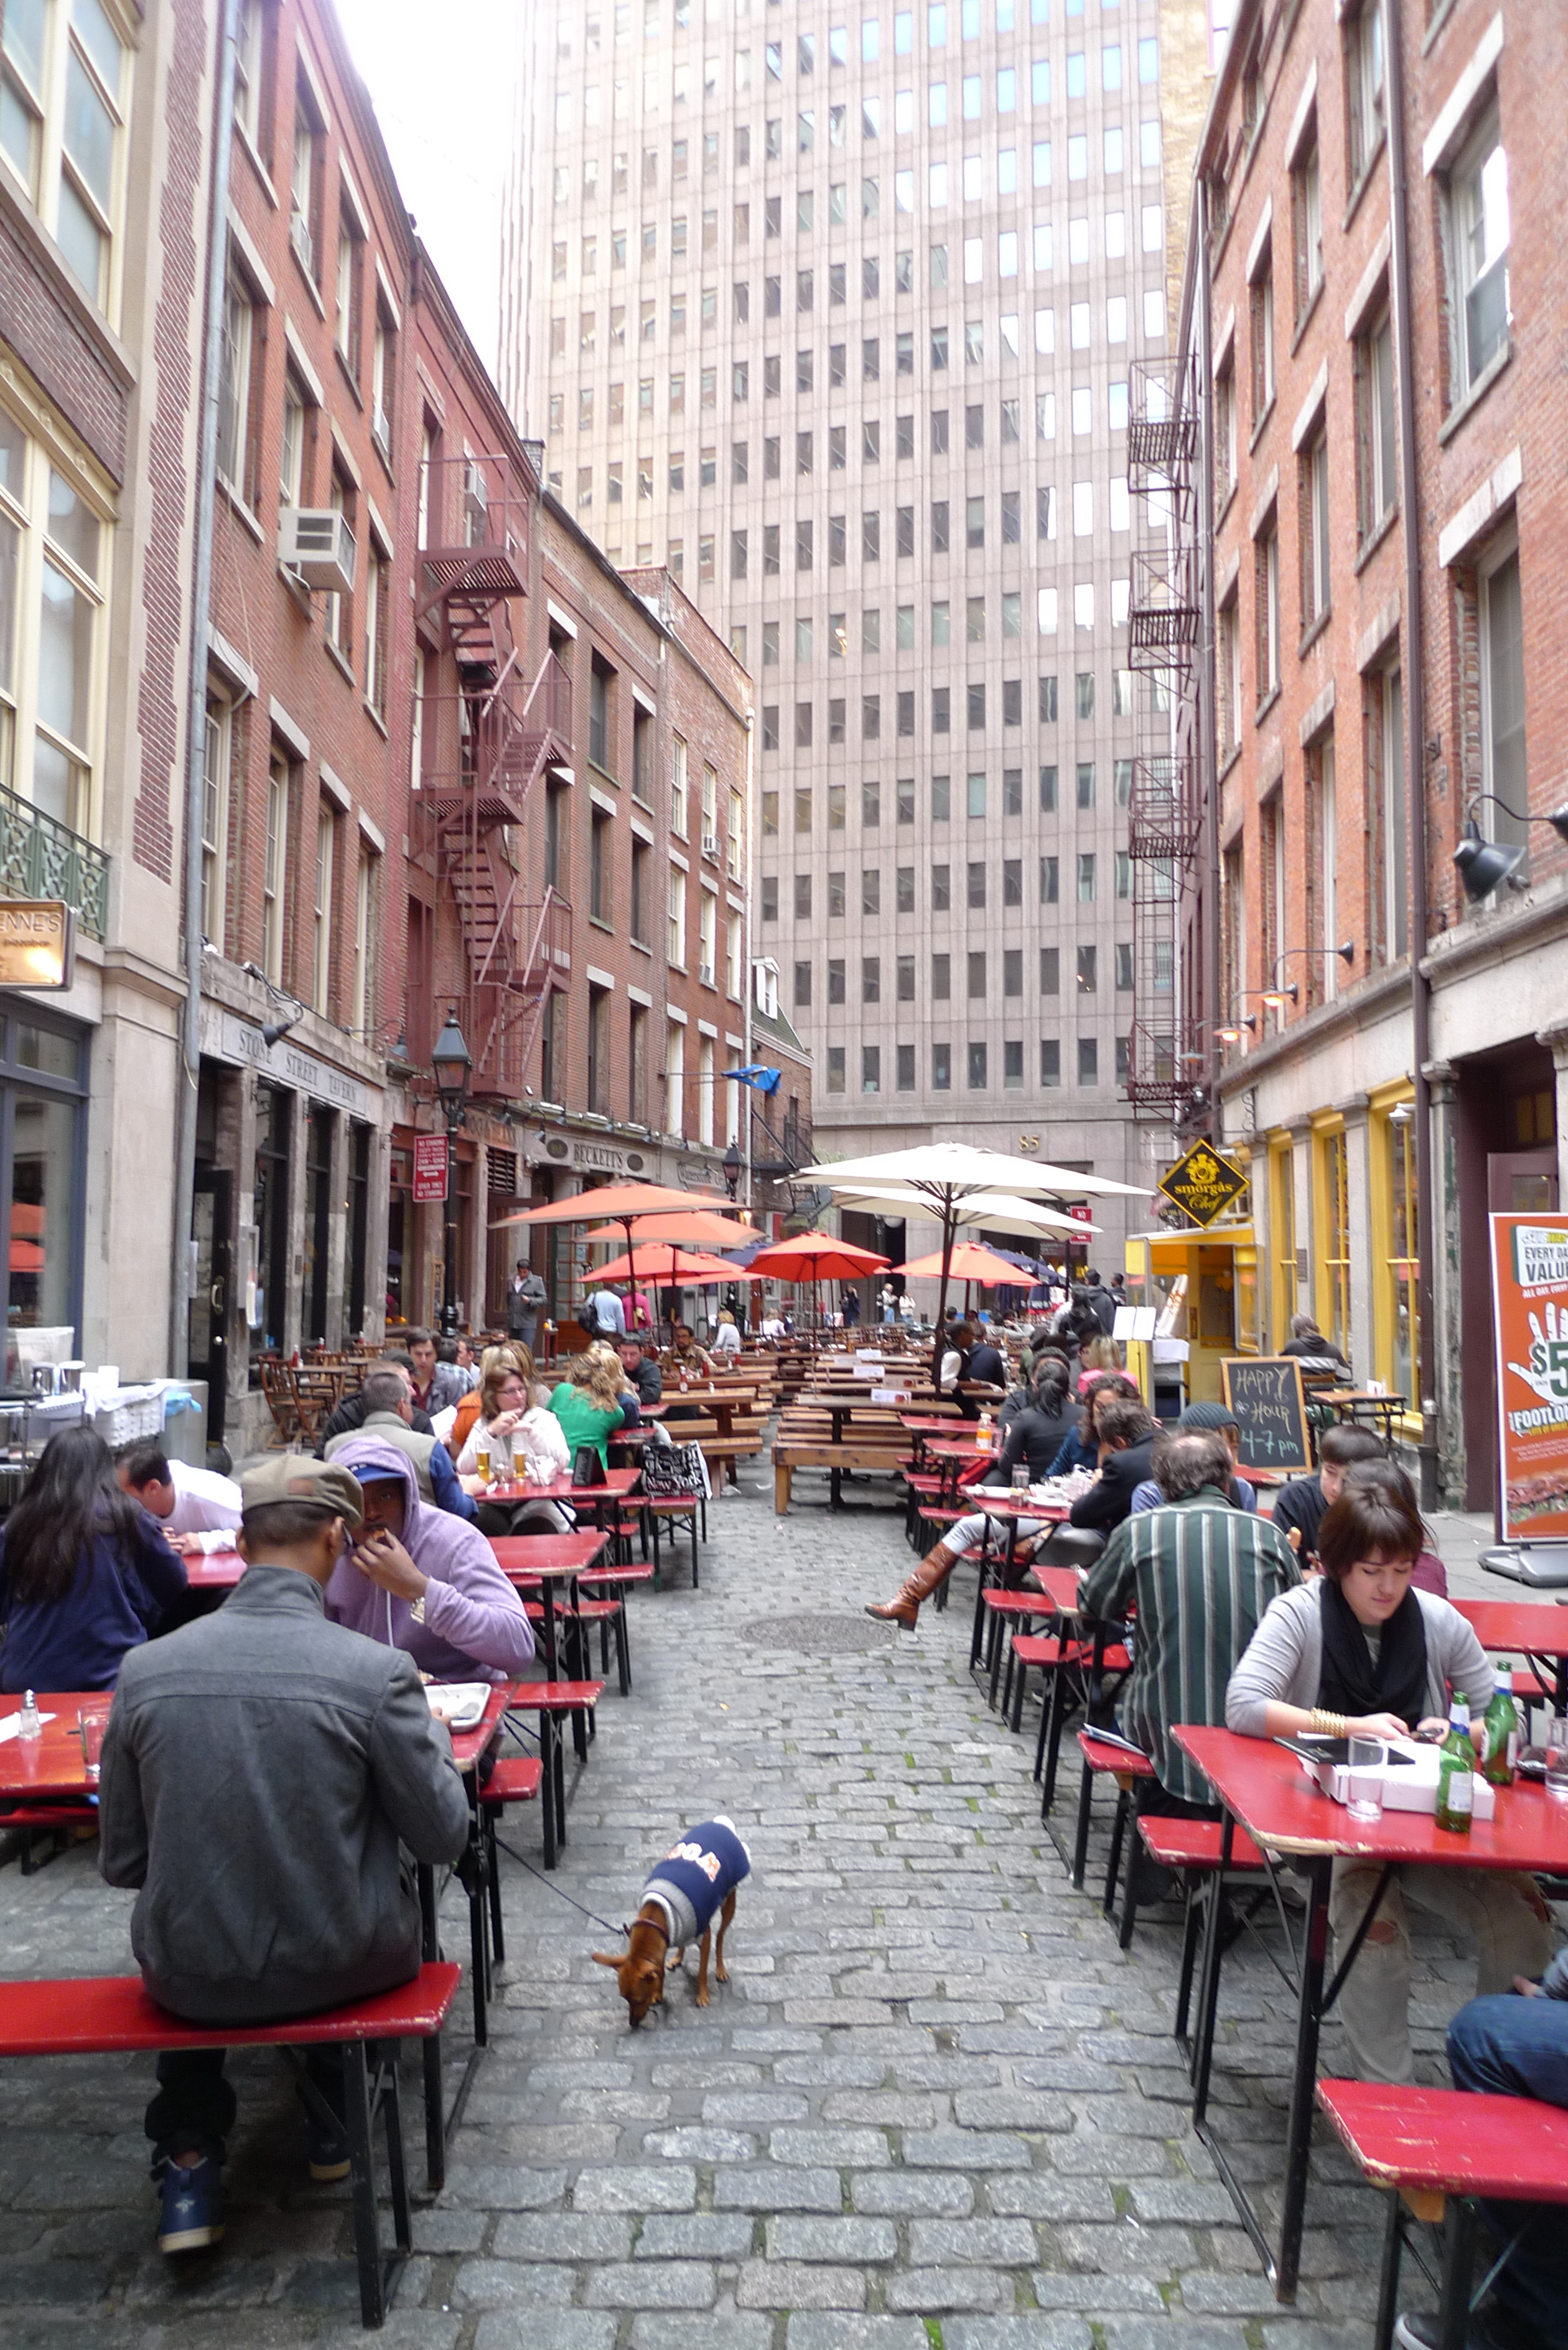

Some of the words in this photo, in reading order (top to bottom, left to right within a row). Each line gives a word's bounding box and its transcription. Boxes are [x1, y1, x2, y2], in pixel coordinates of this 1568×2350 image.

[240, 1029, 273, 1065] STONE
[286, 1052, 319, 1086] STREET
[329, 1074, 357, 1103] TAVERN
[1018, 1134, 1040, 1153] 85
[1524, 1247, 1554, 1259] EVERY
[1522, 1288, 1536, 1299] ALL
[1235, 1366, 1289, 1401] HAPPY
[1251, 1400, 1292, 1436] HOUR
[672, 1471, 702, 1491] York
